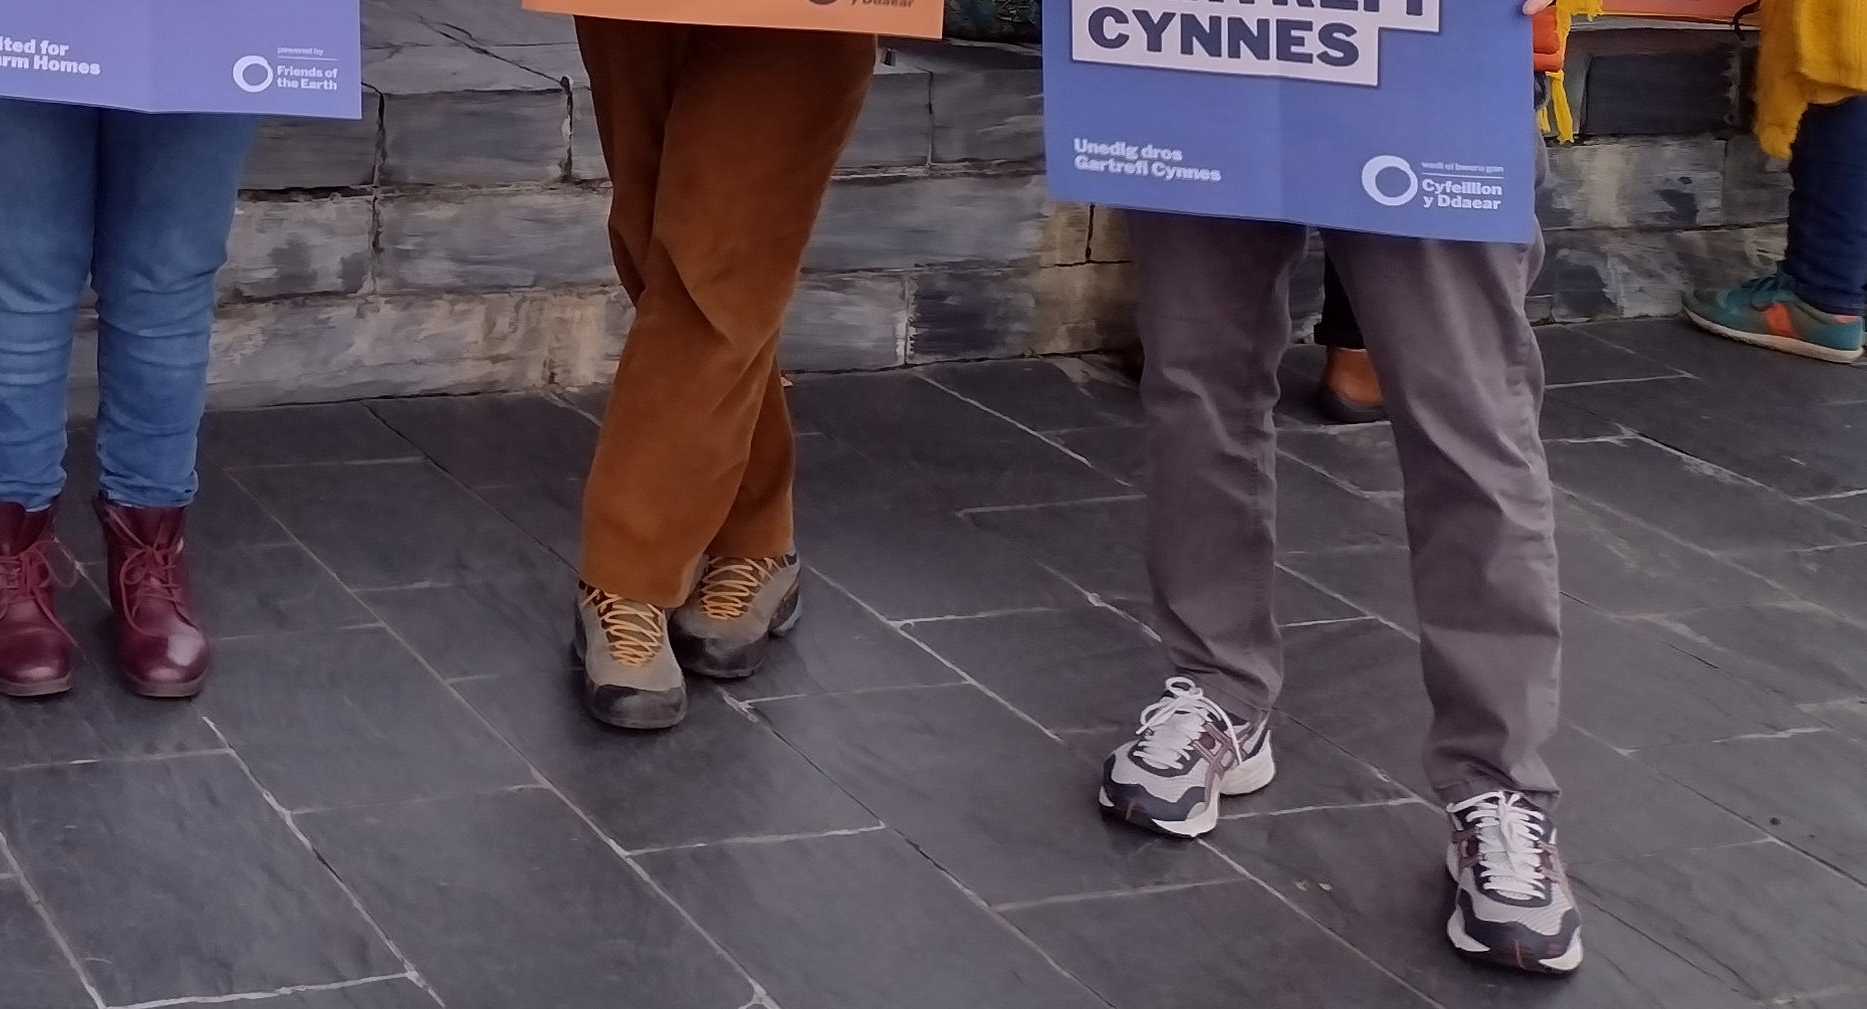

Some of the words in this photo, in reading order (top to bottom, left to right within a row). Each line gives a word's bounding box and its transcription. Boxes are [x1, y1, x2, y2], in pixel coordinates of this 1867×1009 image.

[1088, 6, 1360, 66] CYNNES
[40, 40, 69, 56] for
[33, 55, 101, 75] Homes
[276, 65, 323, 77] Friends
[325, 68, 338, 78] of
[277, 77, 298, 88] the
[301, 78, 338, 90] Earth
[1073, 137, 1139, 160] Unedig
[1141, 144, 1183, 162] dros
[1074, 154, 1149, 176] Gartrefi
[1151, 161, 1221, 181] Cynnes
[1421, 178, 1503, 195] Cyfeillion
[1423, 196, 1433, 208] y
[1437, 195, 1501, 209] Ddaear
